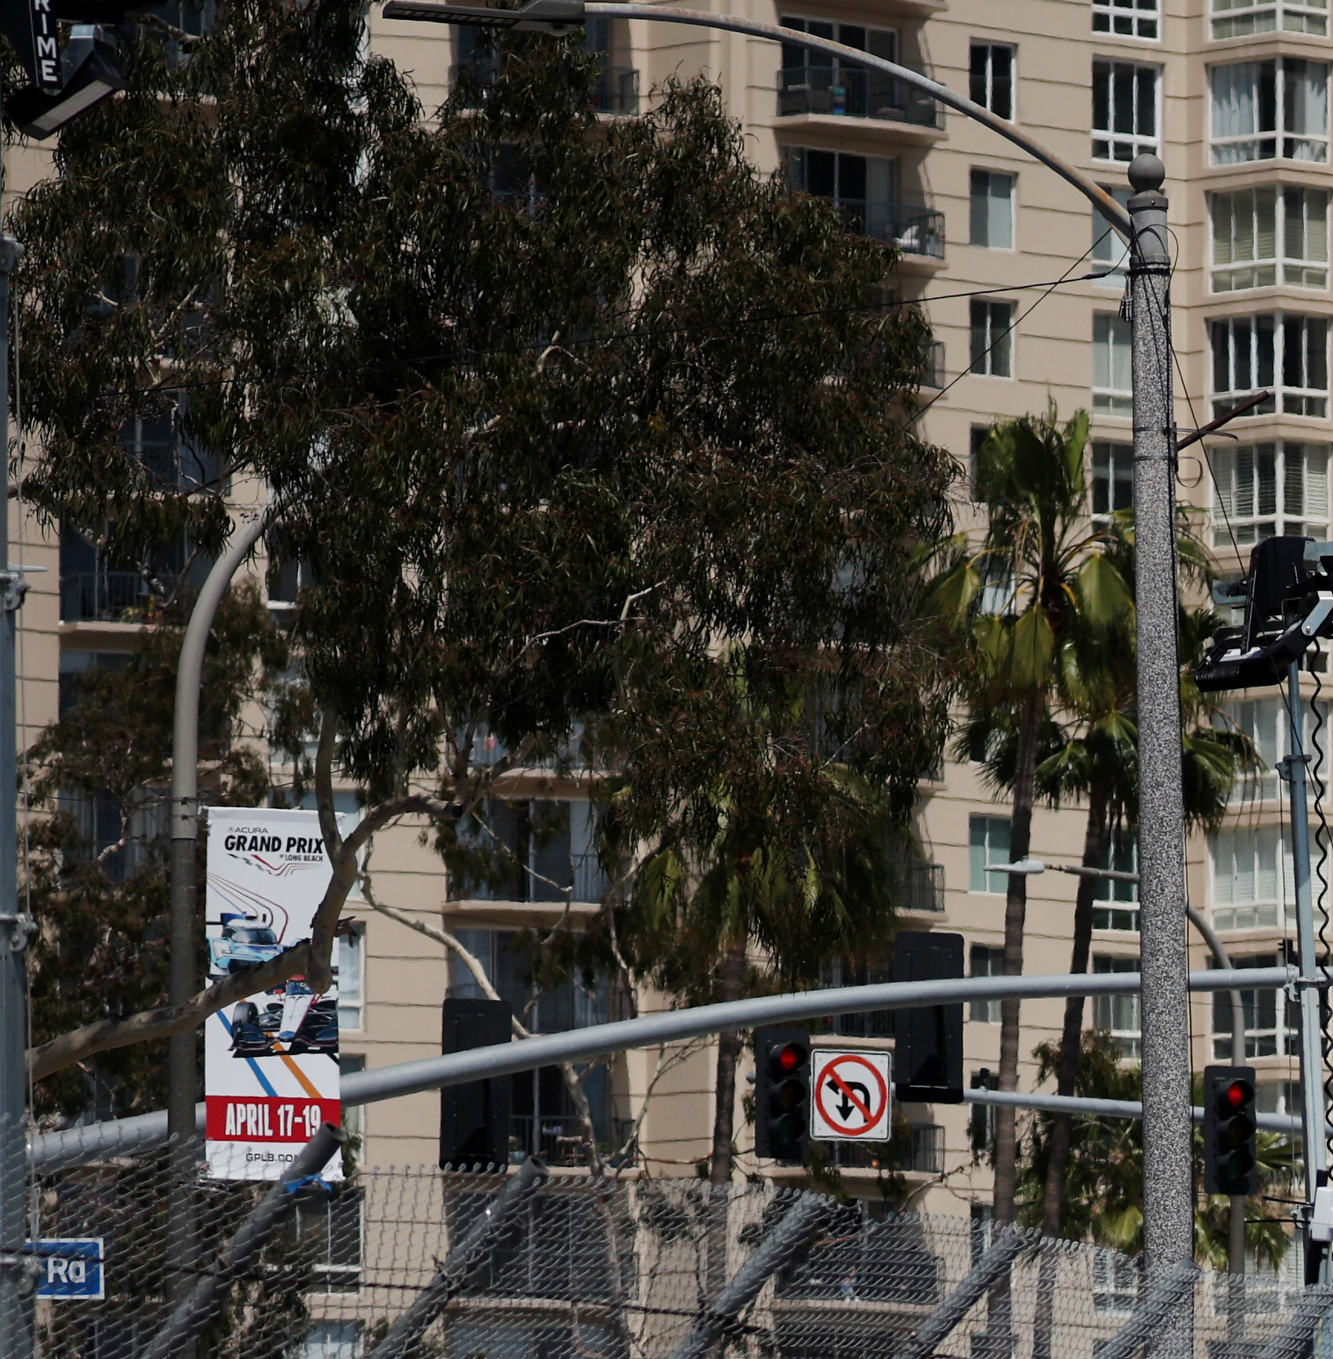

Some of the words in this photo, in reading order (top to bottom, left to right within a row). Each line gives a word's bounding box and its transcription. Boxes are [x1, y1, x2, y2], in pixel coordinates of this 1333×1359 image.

[225, 835, 281, 852] GRAND
[286, 837, 324, 854] PRIX
[225, 1103, 273, 1136] APRIL
[277, 1104, 321, 1137] 17-19
[246, 1153, 299, 1162] GPLB.CO
[47, 1255, 86, 1283] Rd
